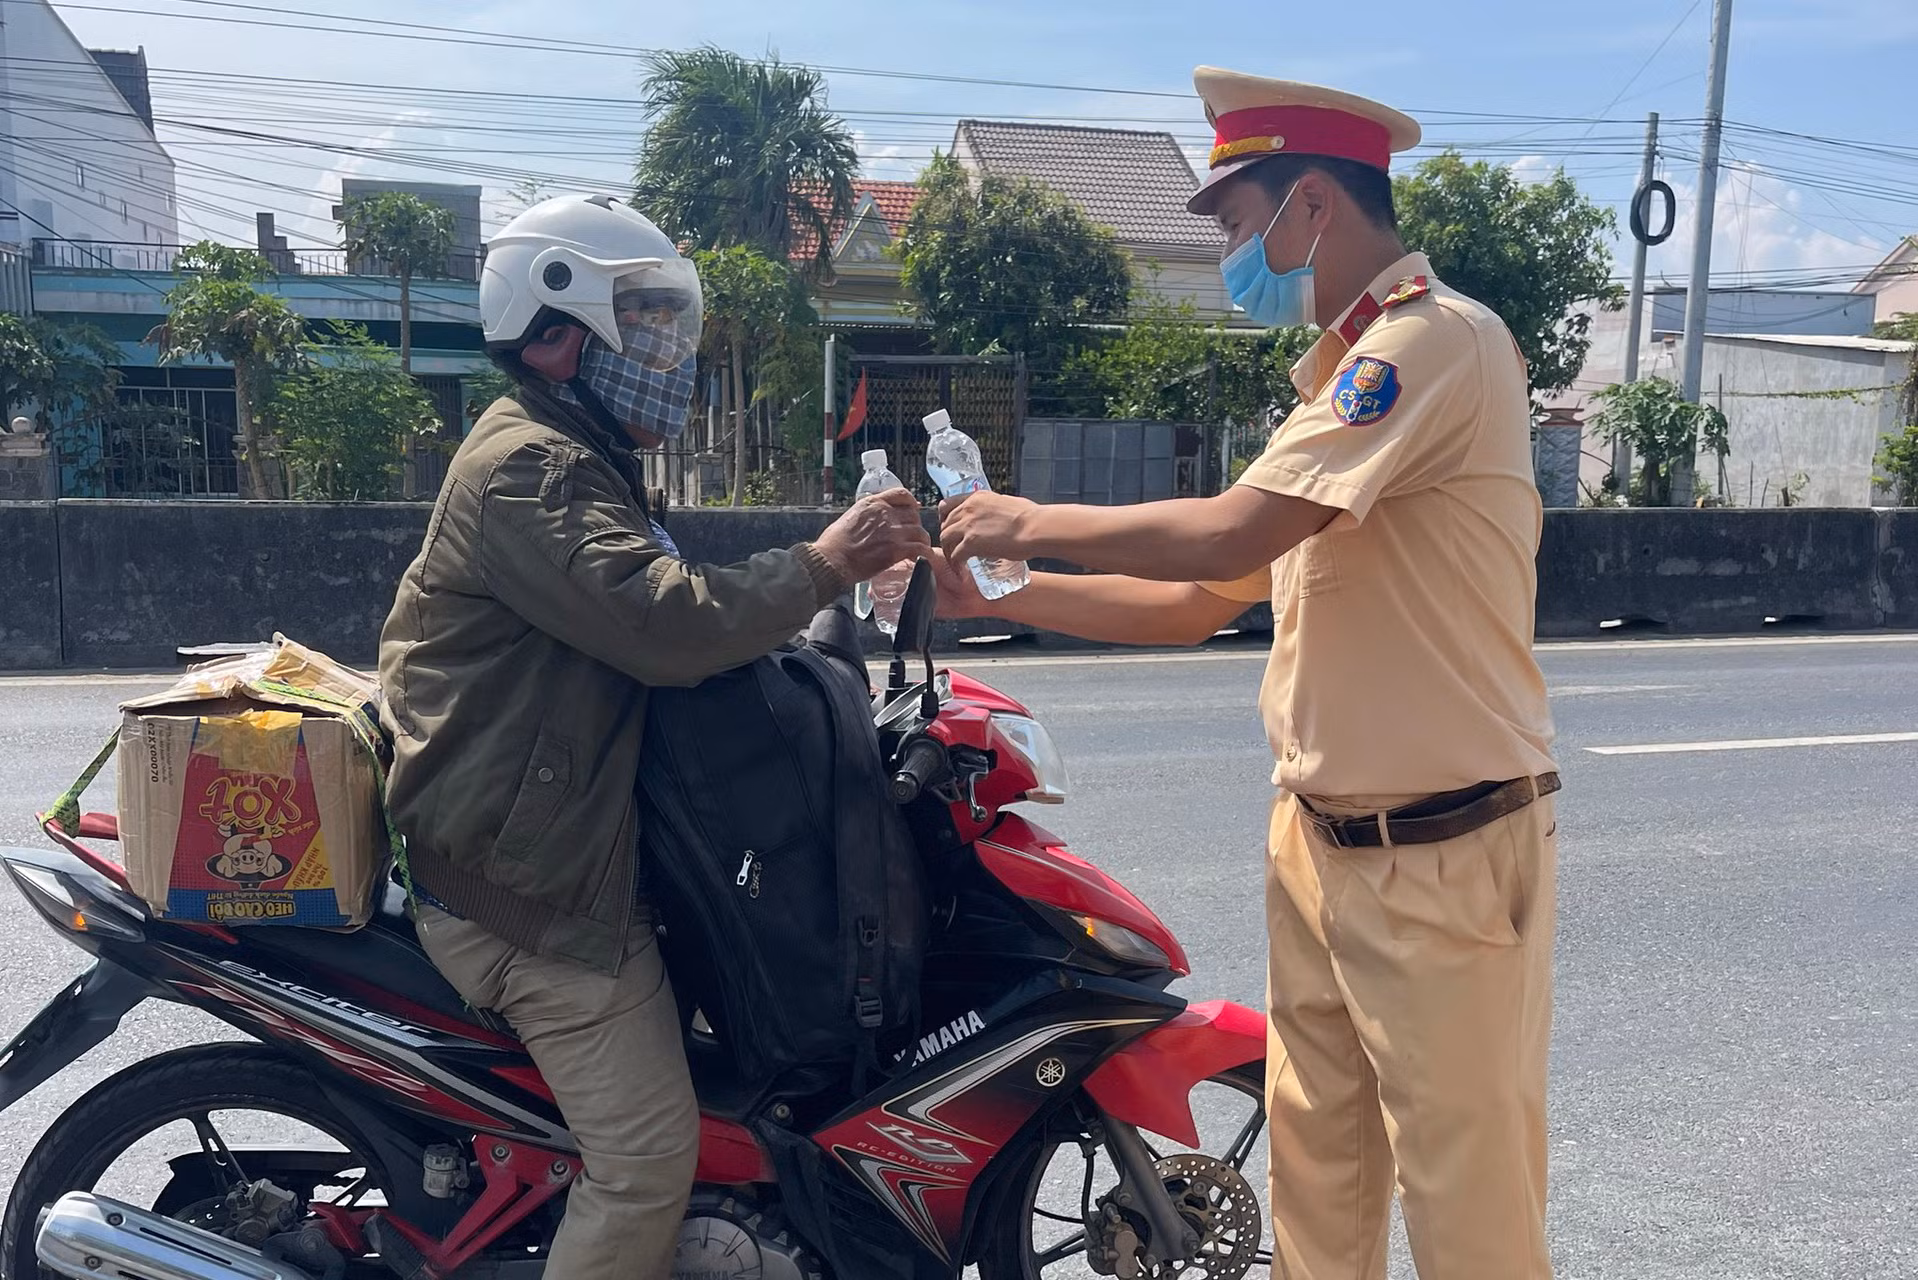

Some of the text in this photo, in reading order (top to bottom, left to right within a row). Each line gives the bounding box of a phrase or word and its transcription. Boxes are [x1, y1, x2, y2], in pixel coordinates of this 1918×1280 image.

[1339, 389, 1382, 410] CS GT
[234, 901, 264, 918] CAO
[265, 902, 294, 917] HEO
